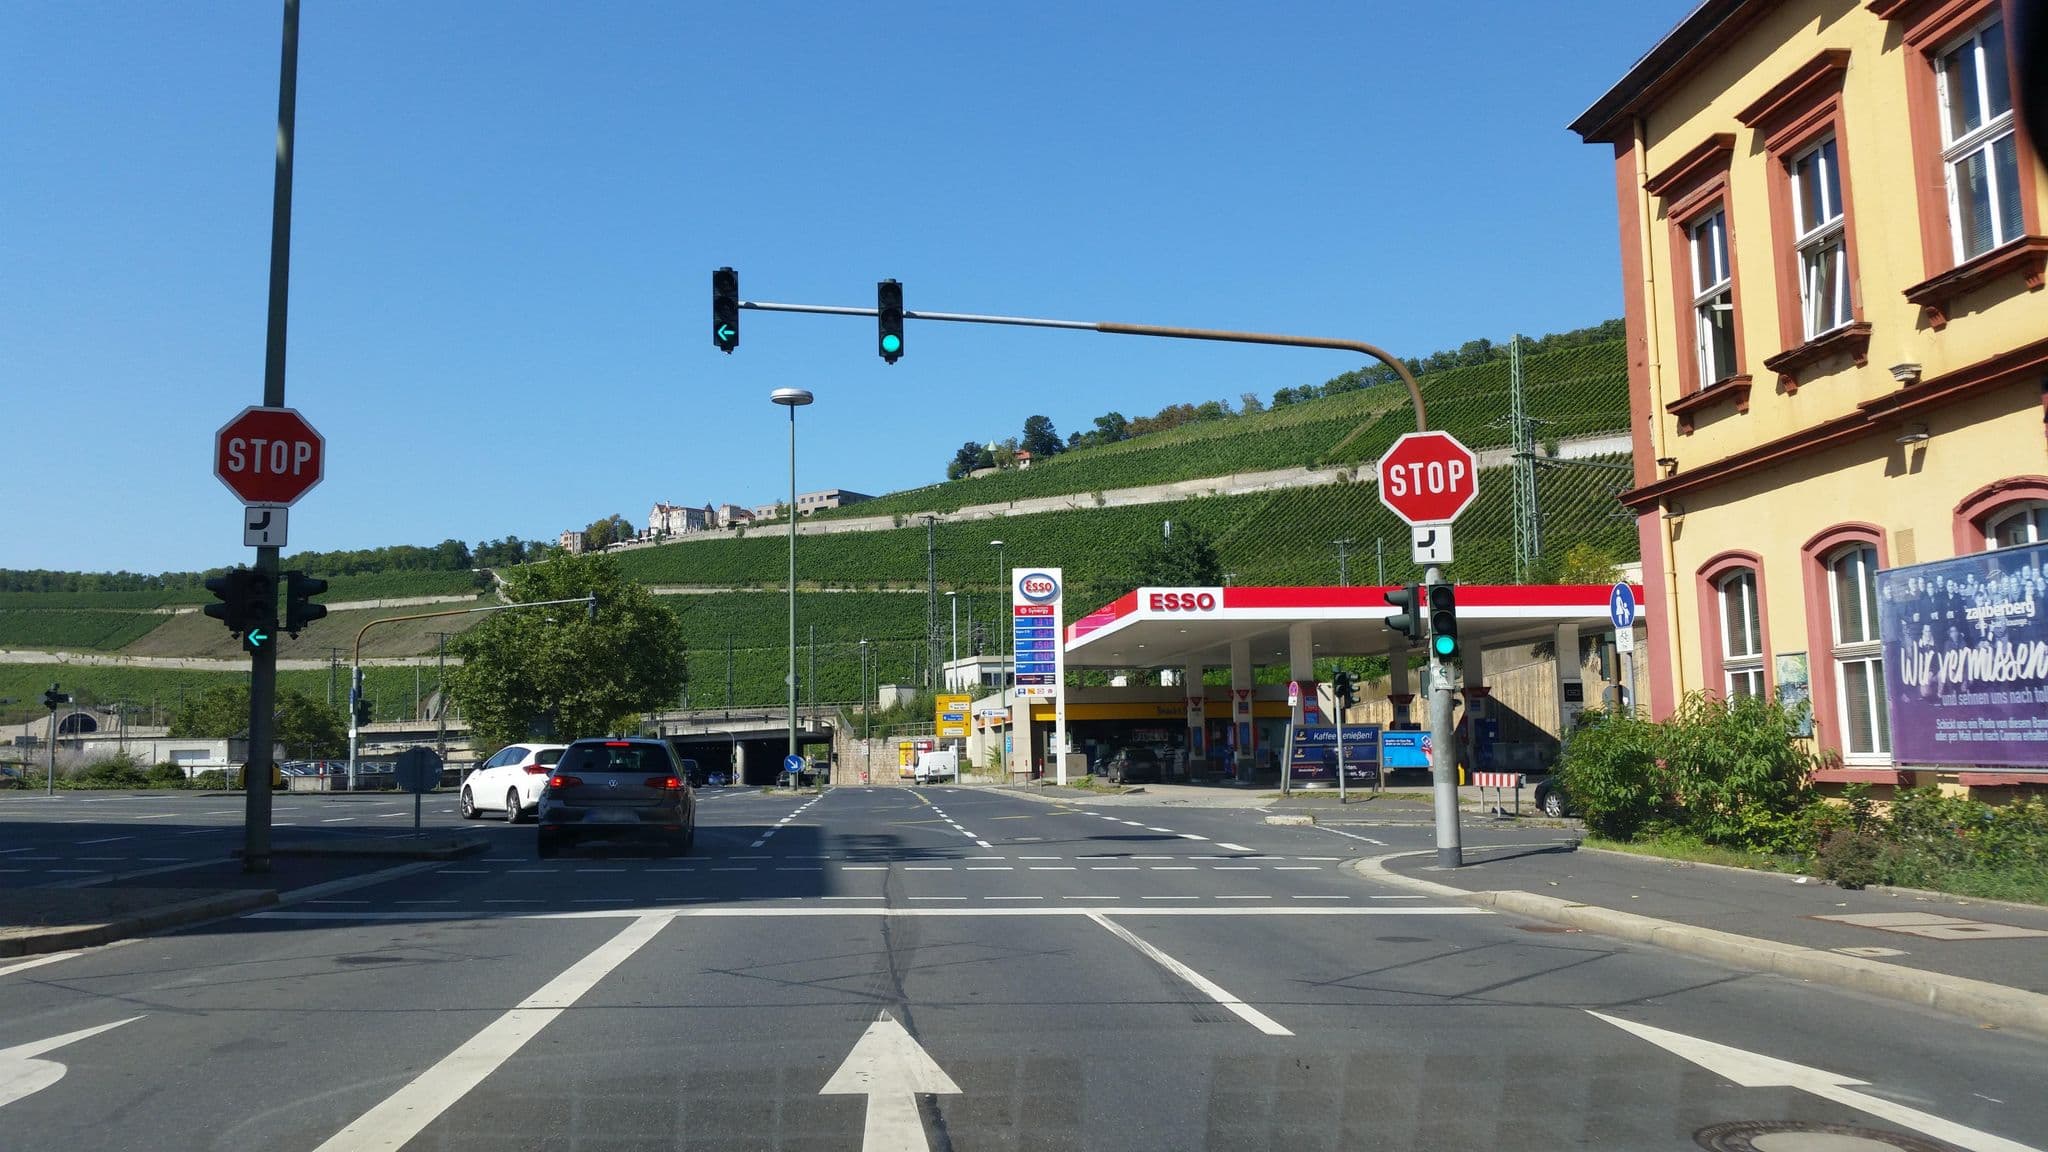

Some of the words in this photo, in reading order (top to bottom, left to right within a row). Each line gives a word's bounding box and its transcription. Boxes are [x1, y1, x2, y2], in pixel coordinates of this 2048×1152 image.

[228, 437, 312, 475] STOP
[1390, 460, 1465, 496] STOP
[1025, 579, 1052, 593] Esso
[1150, 593, 1215, 610] ESSO
[1965, 599, 2036, 621] zauberberg
[1901, 641, 1935, 687] Wir
[1937, 640, 2048, 684] vermissen
[1958, 689, 1990, 705] sehnen
[1990, 692, 2008, 704] uns
[2009, 686, 2034, 704] nach
[1313, 732, 1337, 741] Kaffee
[1340, 731, 1373, 741] enießen!
